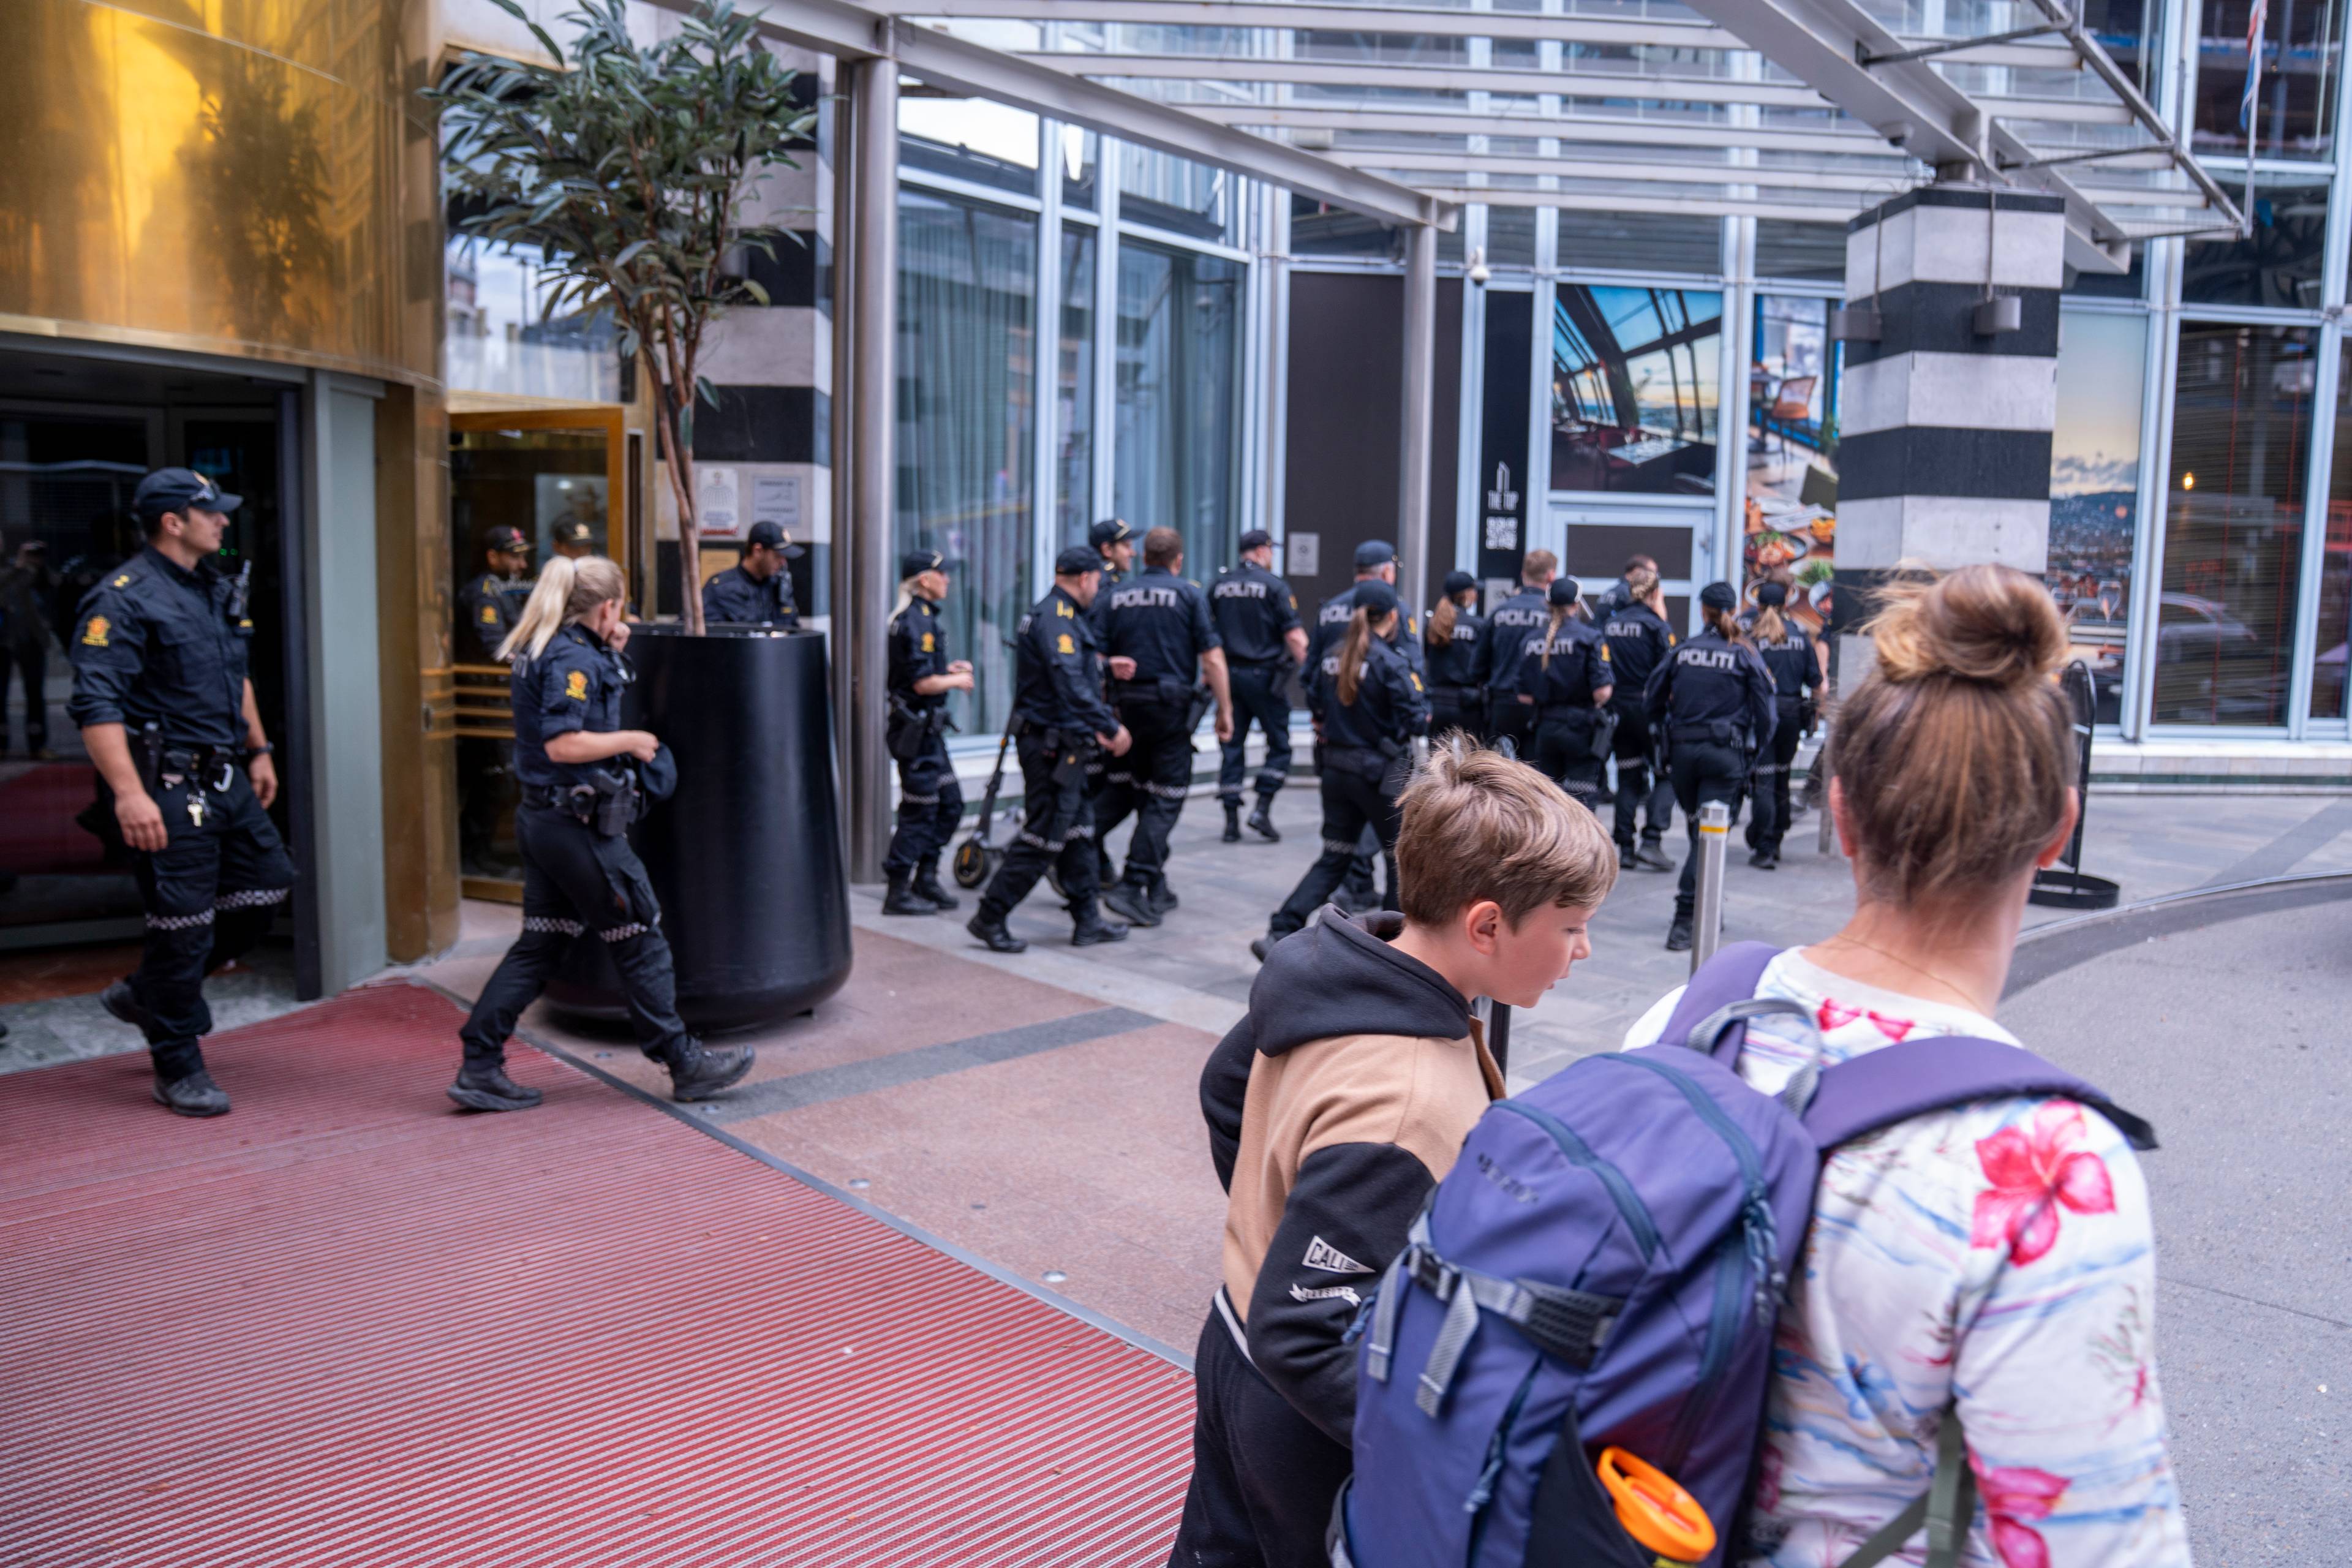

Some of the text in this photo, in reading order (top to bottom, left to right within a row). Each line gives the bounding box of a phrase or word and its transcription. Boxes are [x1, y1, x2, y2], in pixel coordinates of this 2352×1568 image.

[1111, 586, 1177, 609] POLITI
[1214, 581, 1266, 598] POLITI
[1319, 604, 1355, 626] POL
[1677, 647, 1735, 669] POLITI
[1309, 1243, 1345, 1270] CALI
